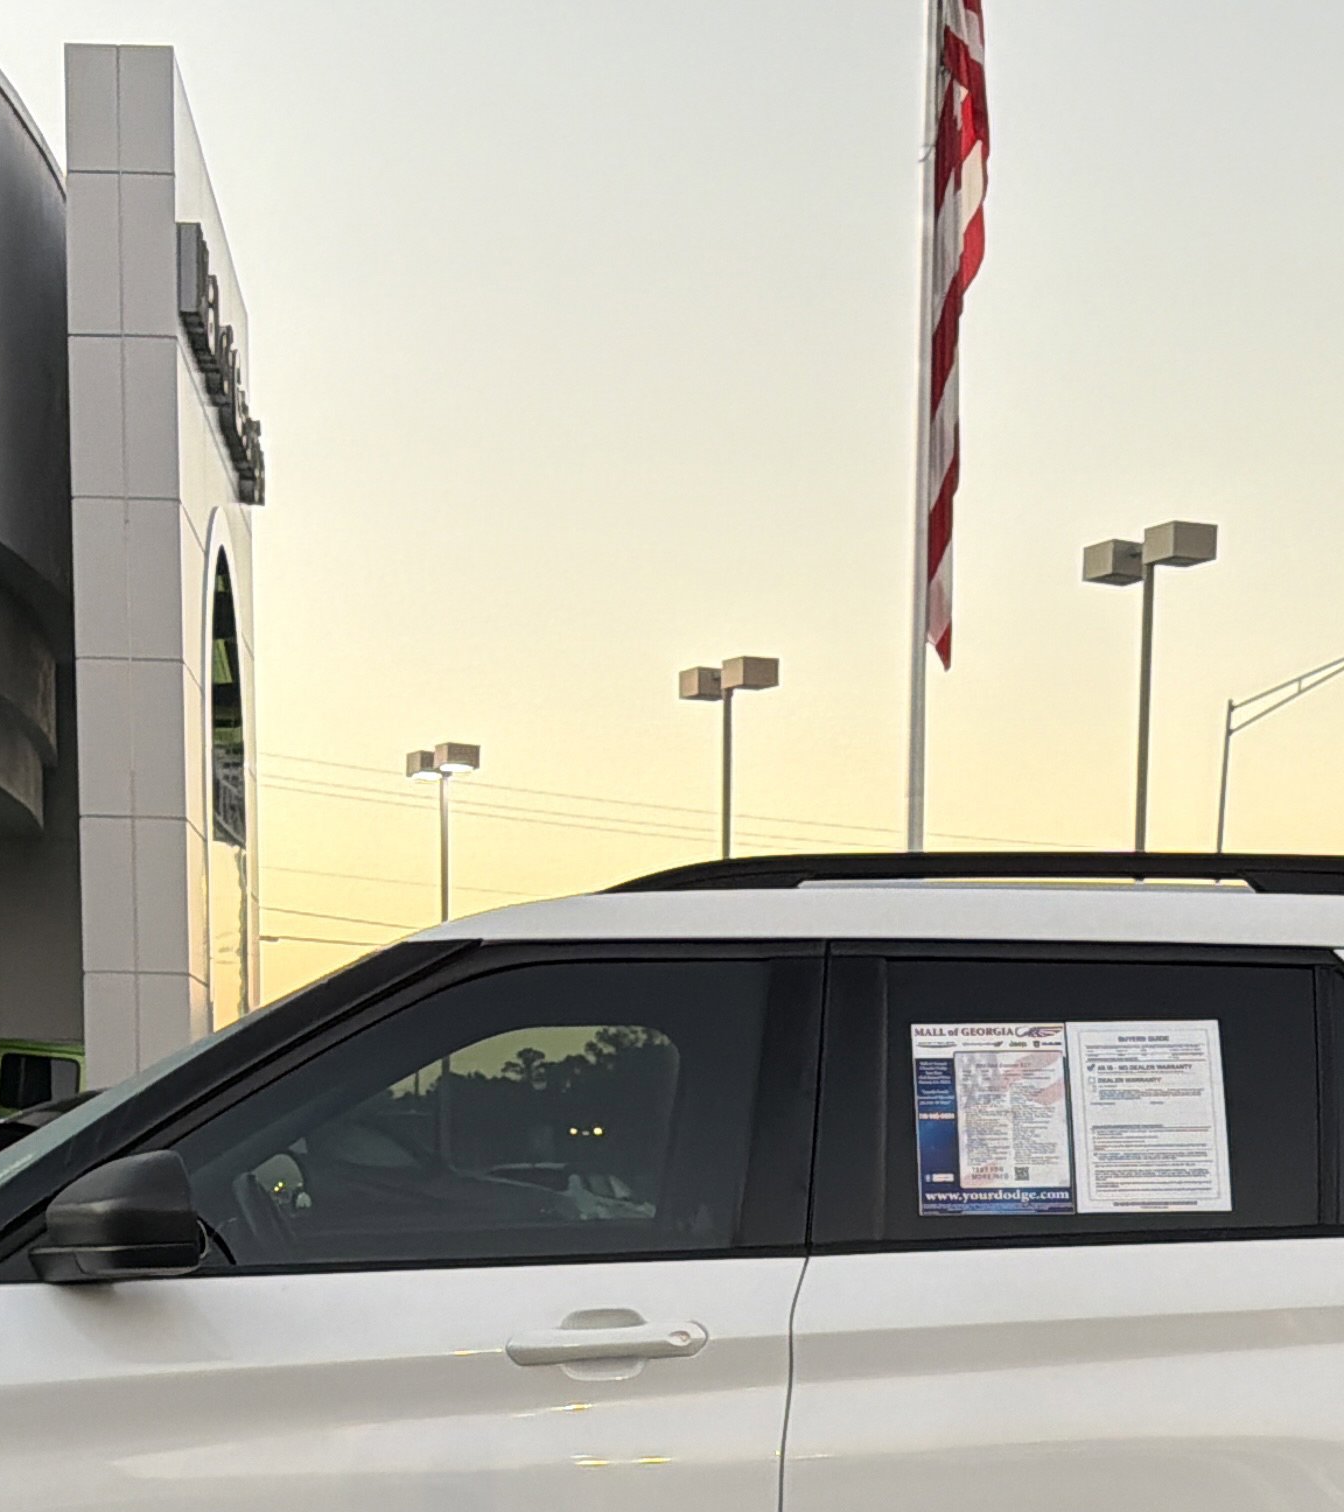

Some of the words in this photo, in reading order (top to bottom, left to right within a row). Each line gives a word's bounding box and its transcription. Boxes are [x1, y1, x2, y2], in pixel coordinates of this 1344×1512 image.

[914, 1027, 945, 1037] MALL
[948, 1026, 959, 1037] of
[961, 1026, 1014, 1037] GEORGIA
[925, 1189, 1070, 1203] www.yourdodge.com
